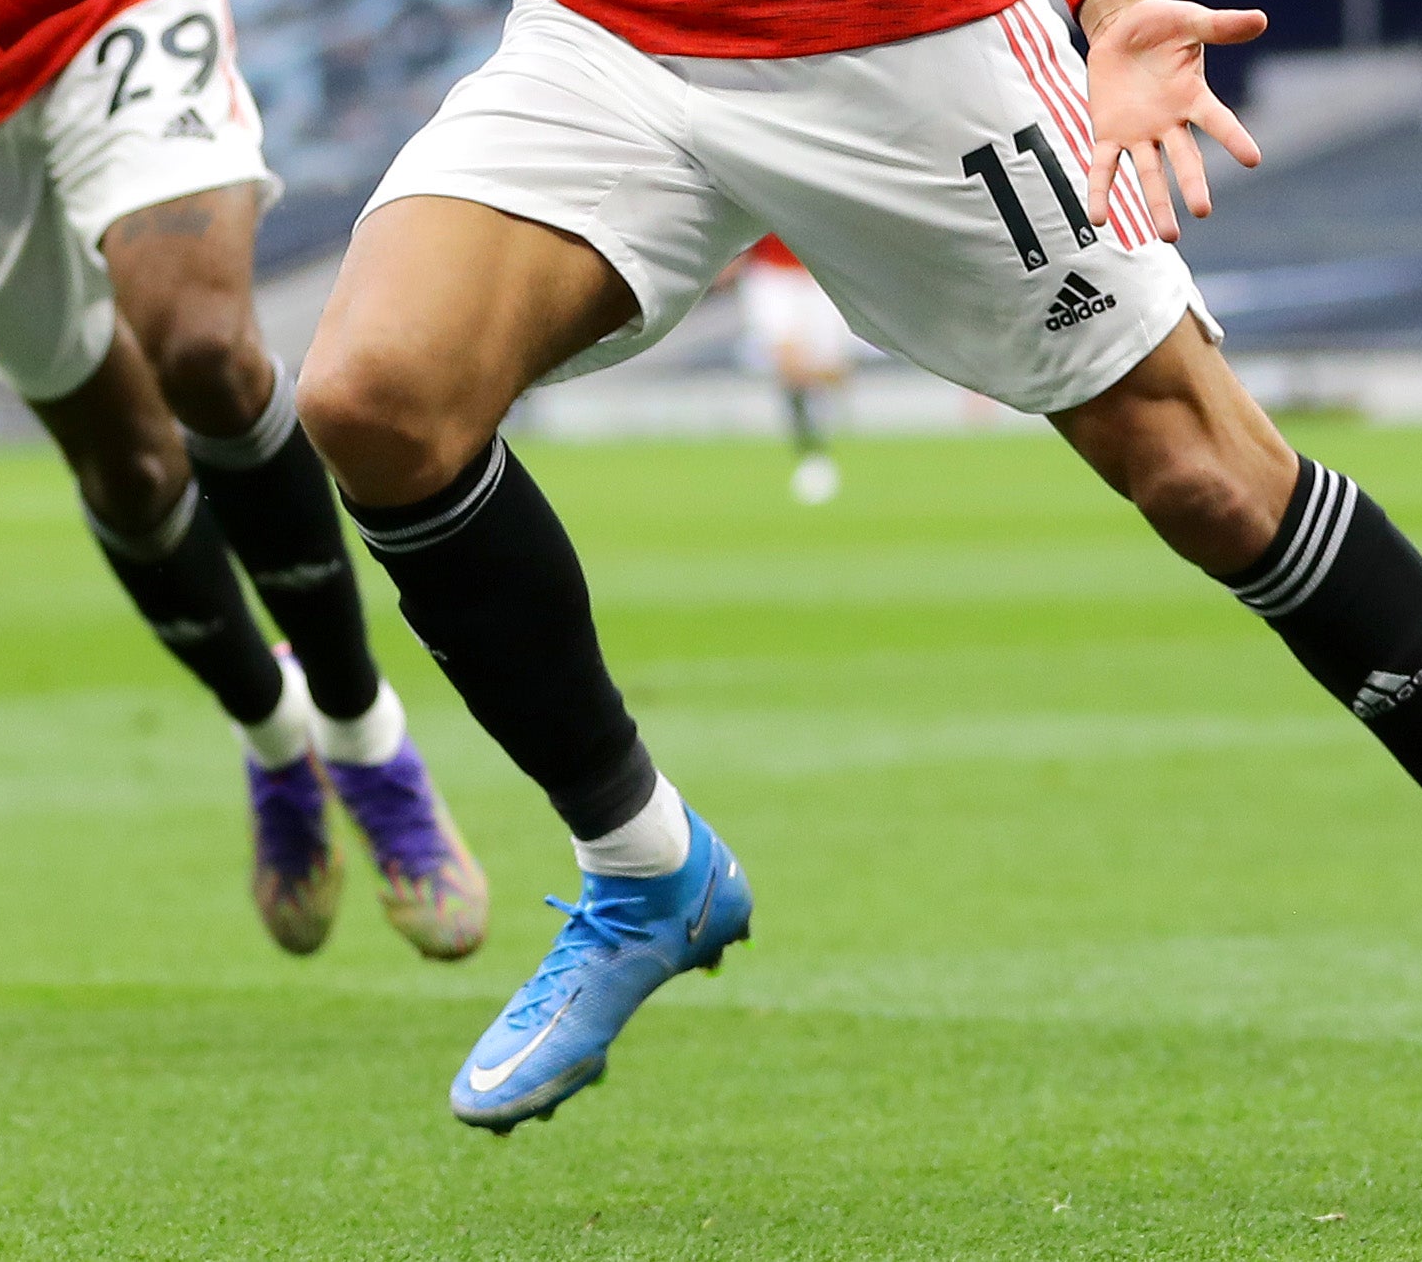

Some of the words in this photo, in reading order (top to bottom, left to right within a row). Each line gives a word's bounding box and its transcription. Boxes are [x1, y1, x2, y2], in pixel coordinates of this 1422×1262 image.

[96, 13, 220, 120] 29
[960, 122, 1099, 273] 11
[1045, 293, 1117, 332] adidas
